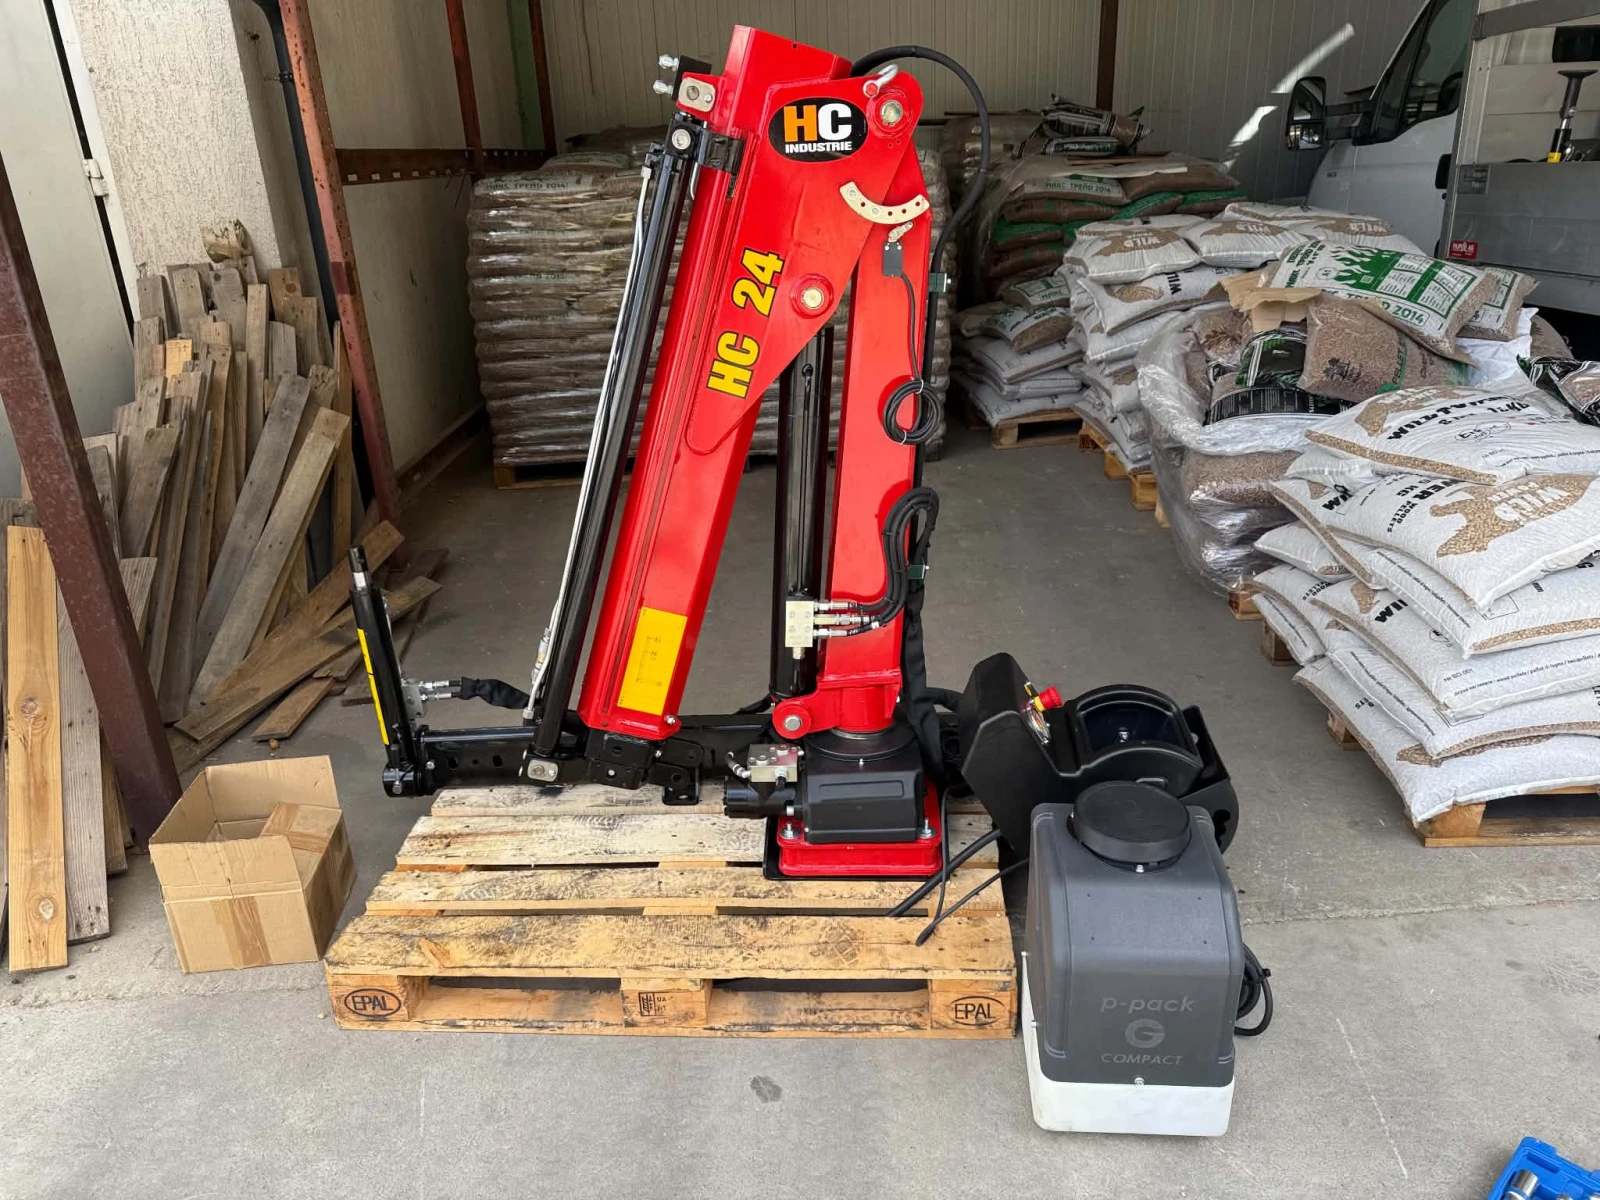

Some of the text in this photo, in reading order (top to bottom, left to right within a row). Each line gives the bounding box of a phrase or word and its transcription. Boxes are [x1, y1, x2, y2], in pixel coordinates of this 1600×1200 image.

[783, 103, 852, 143] HC
[785, 141, 853, 154] INDUSTRIE
[706, 247, 785, 399] HC 24
[1392, 304, 1425, 324] 2014
[1487, 481, 1540, 502] POWER
[1396, 503, 1418, 524] WOOD
[1494, 486, 1571, 522] WILD
[1387, 500, 1412, 533] PELLETS
[351, 993, 390, 1012] EPAL
[954, 1001, 997, 1020] EPAL
[1100, 995, 1195, 1013] p-pack
[1124, 1018, 1166, 1049] G
[1100, 1053, 1184, 1066] COMPACT
